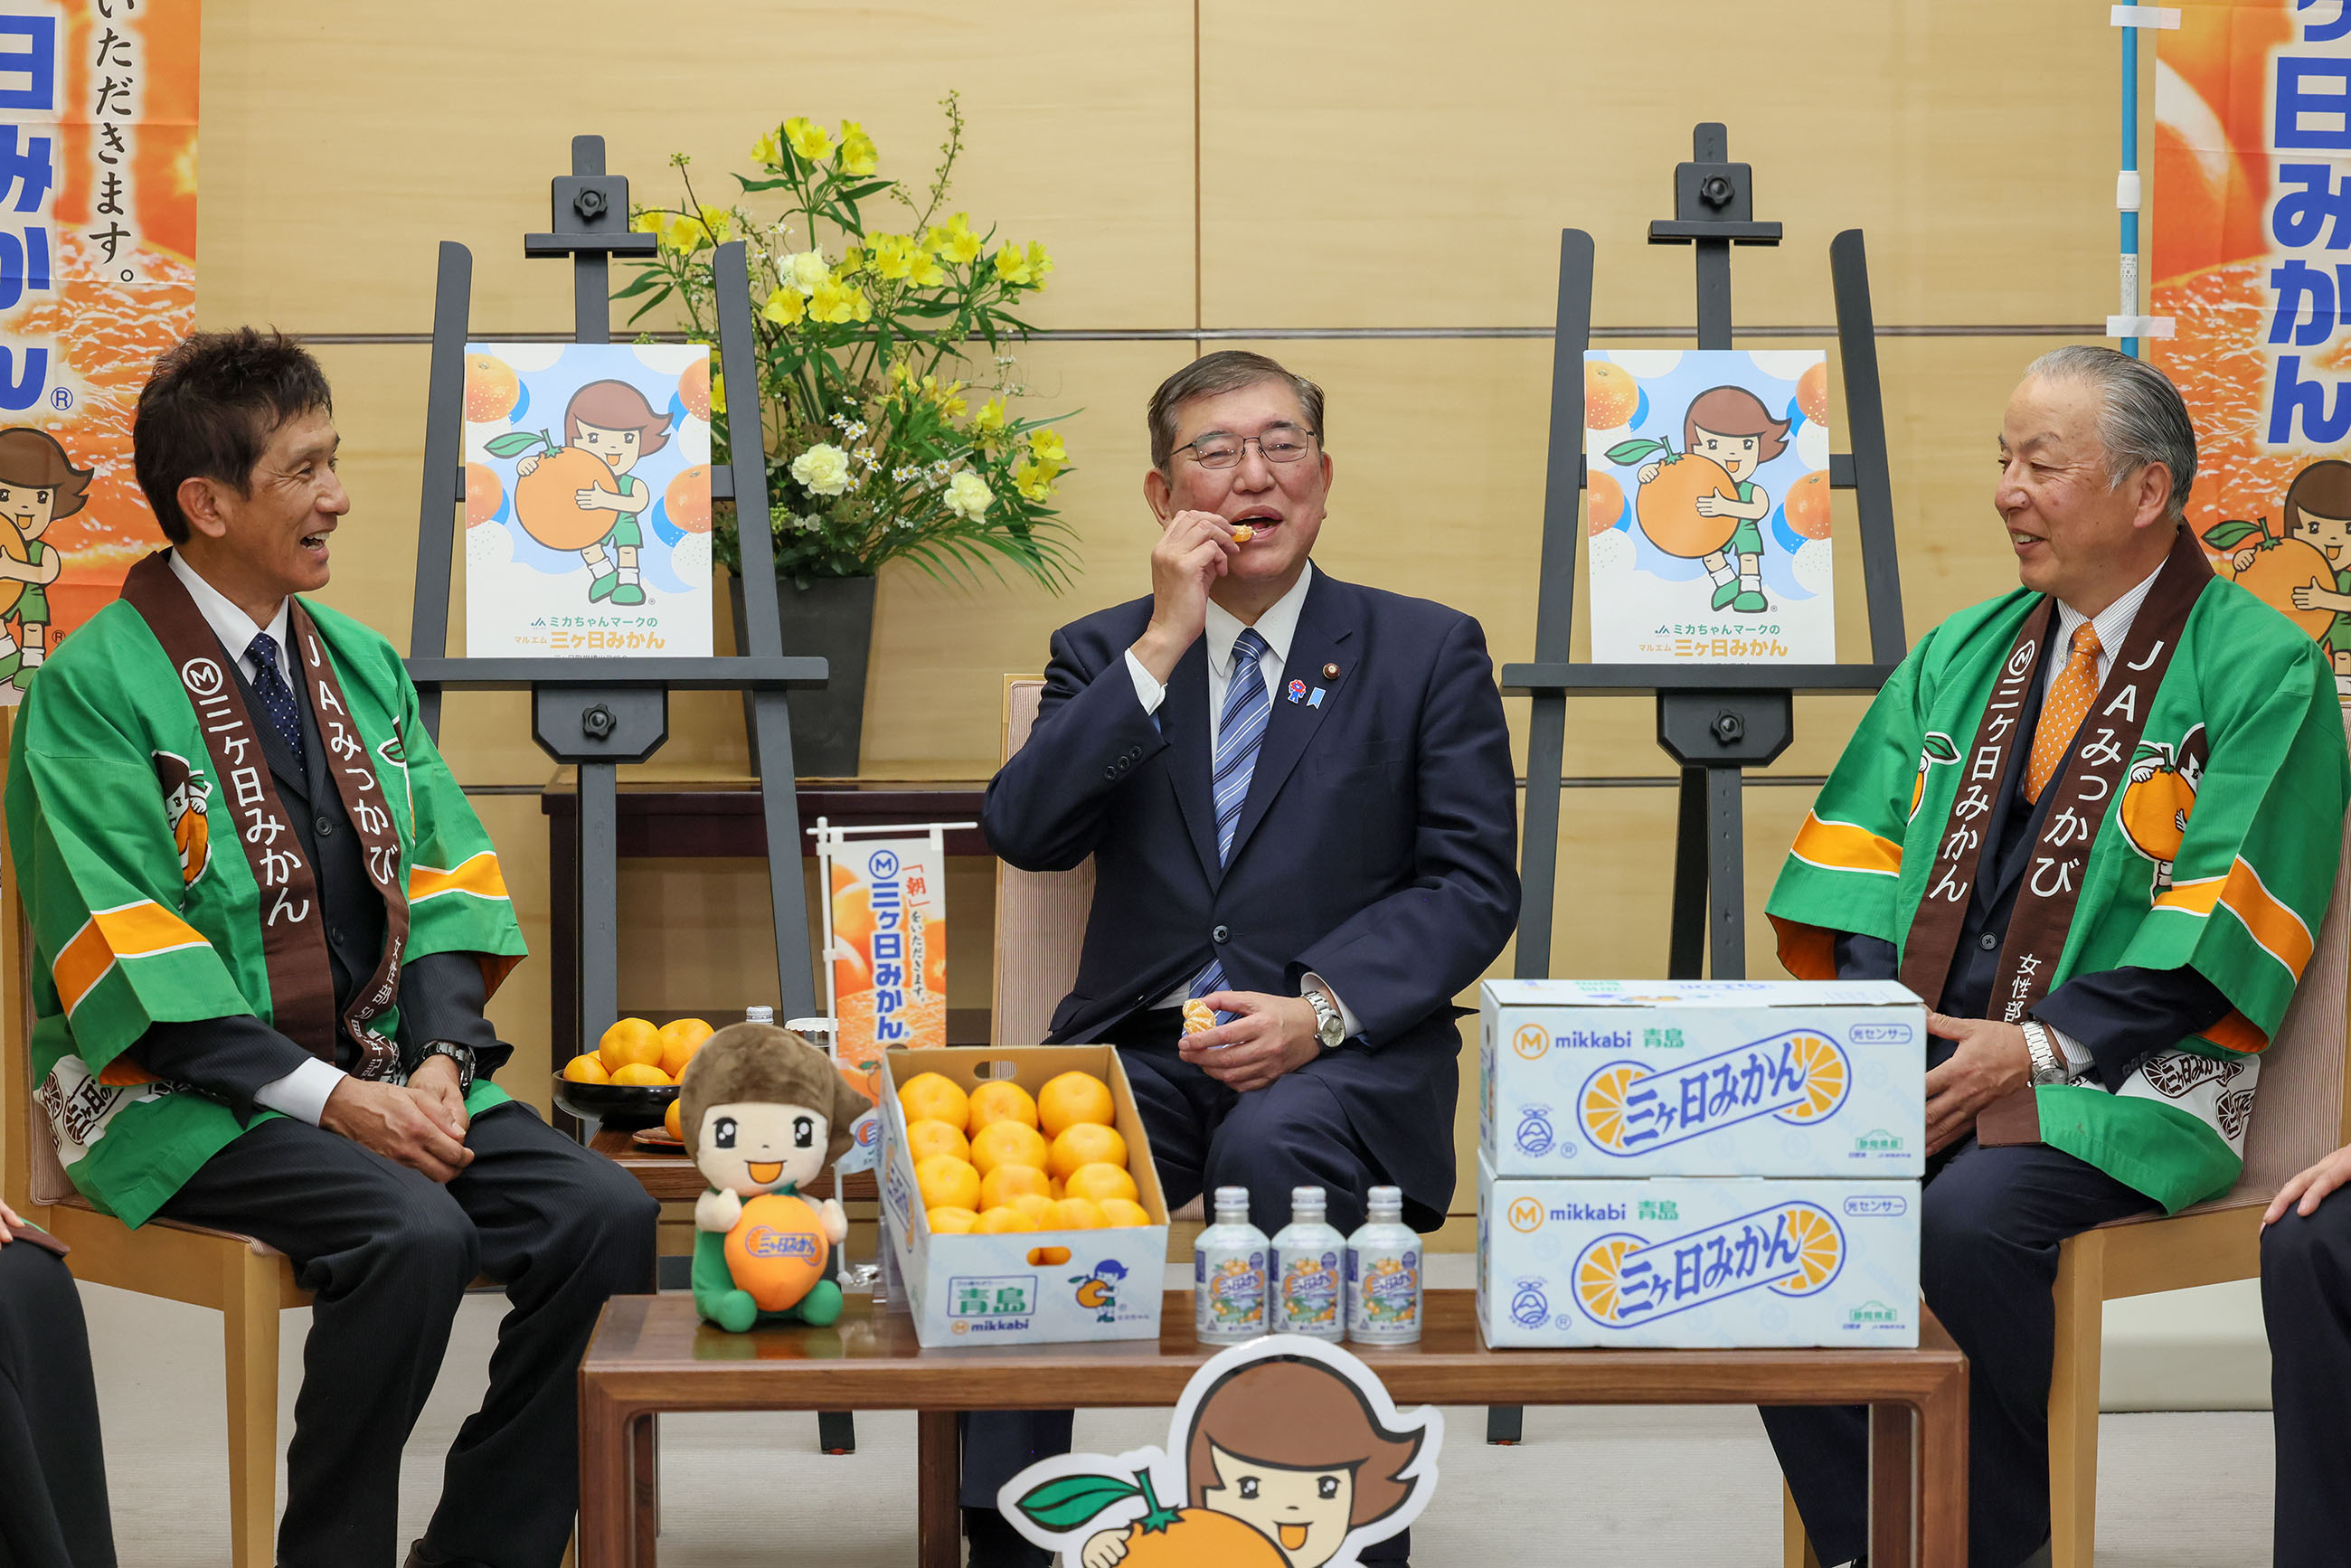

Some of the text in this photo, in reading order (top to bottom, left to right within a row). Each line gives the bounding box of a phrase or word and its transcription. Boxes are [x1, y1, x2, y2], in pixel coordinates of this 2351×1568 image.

[550, 616, 658, 628] ミカちゃんマークの
[1673, 624, 1780, 635] ミカちゃんマークの
[514, 630, 666, 649] マルエム 三ヶ日みかん
[1638, 638, 1789, 657] マルエム 三ヶ日みかん
[1554, 1030, 1632, 1048] mikkabi
[1643, 1028, 1685, 1048] 青島
[1549, 1203, 1626, 1222] mikkabi
[1637, 1201, 1679, 1221] 青島
[958, 1286, 1025, 1314] 青島
[971, 1318, 1029, 1331] mikkabi
